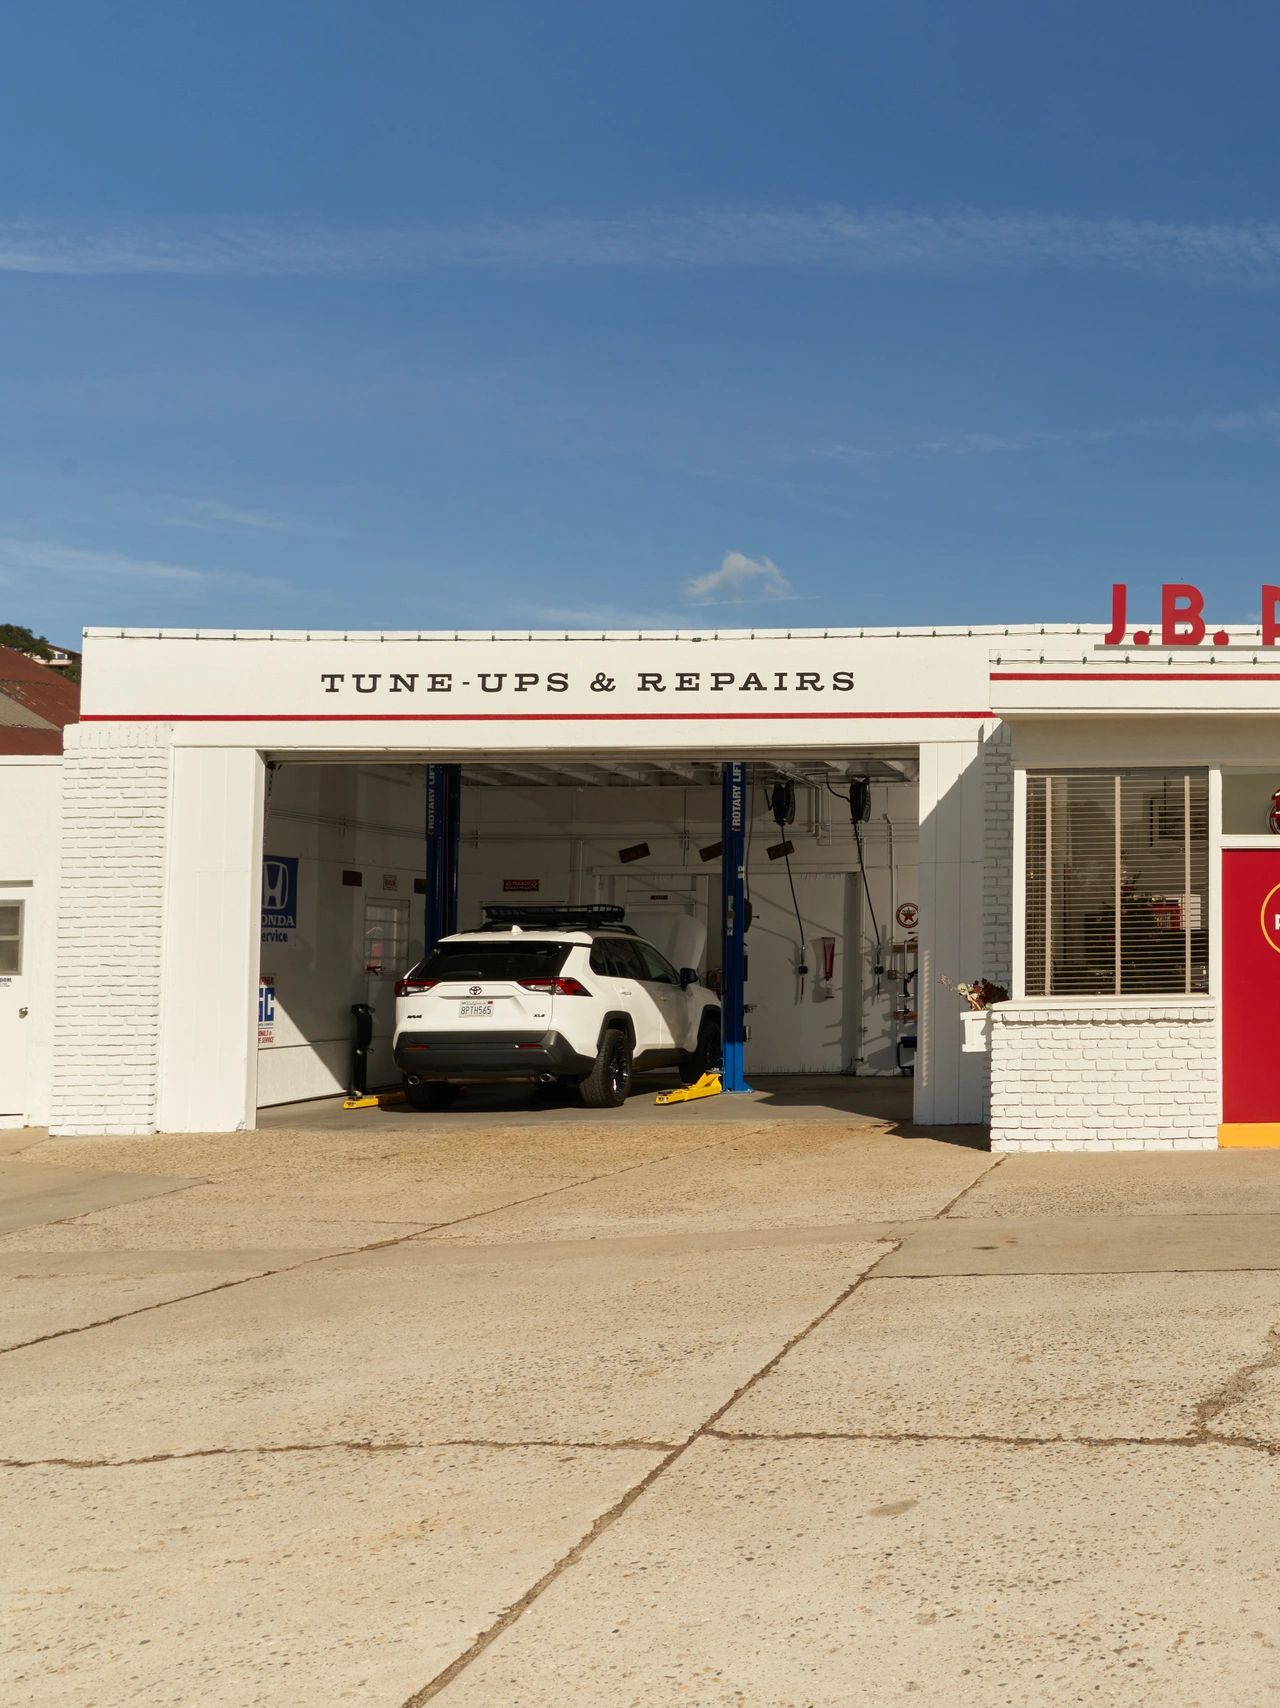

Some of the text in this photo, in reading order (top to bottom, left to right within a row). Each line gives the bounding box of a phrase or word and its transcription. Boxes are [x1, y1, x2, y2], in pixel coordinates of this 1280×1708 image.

[1104, 584, 1229, 646] J.B.
[321, 671, 855, 694] TUNE-UPS & REPAIRS
[732, 785, 741, 827] ROTARY
[261, 930, 288, 942] ervice
